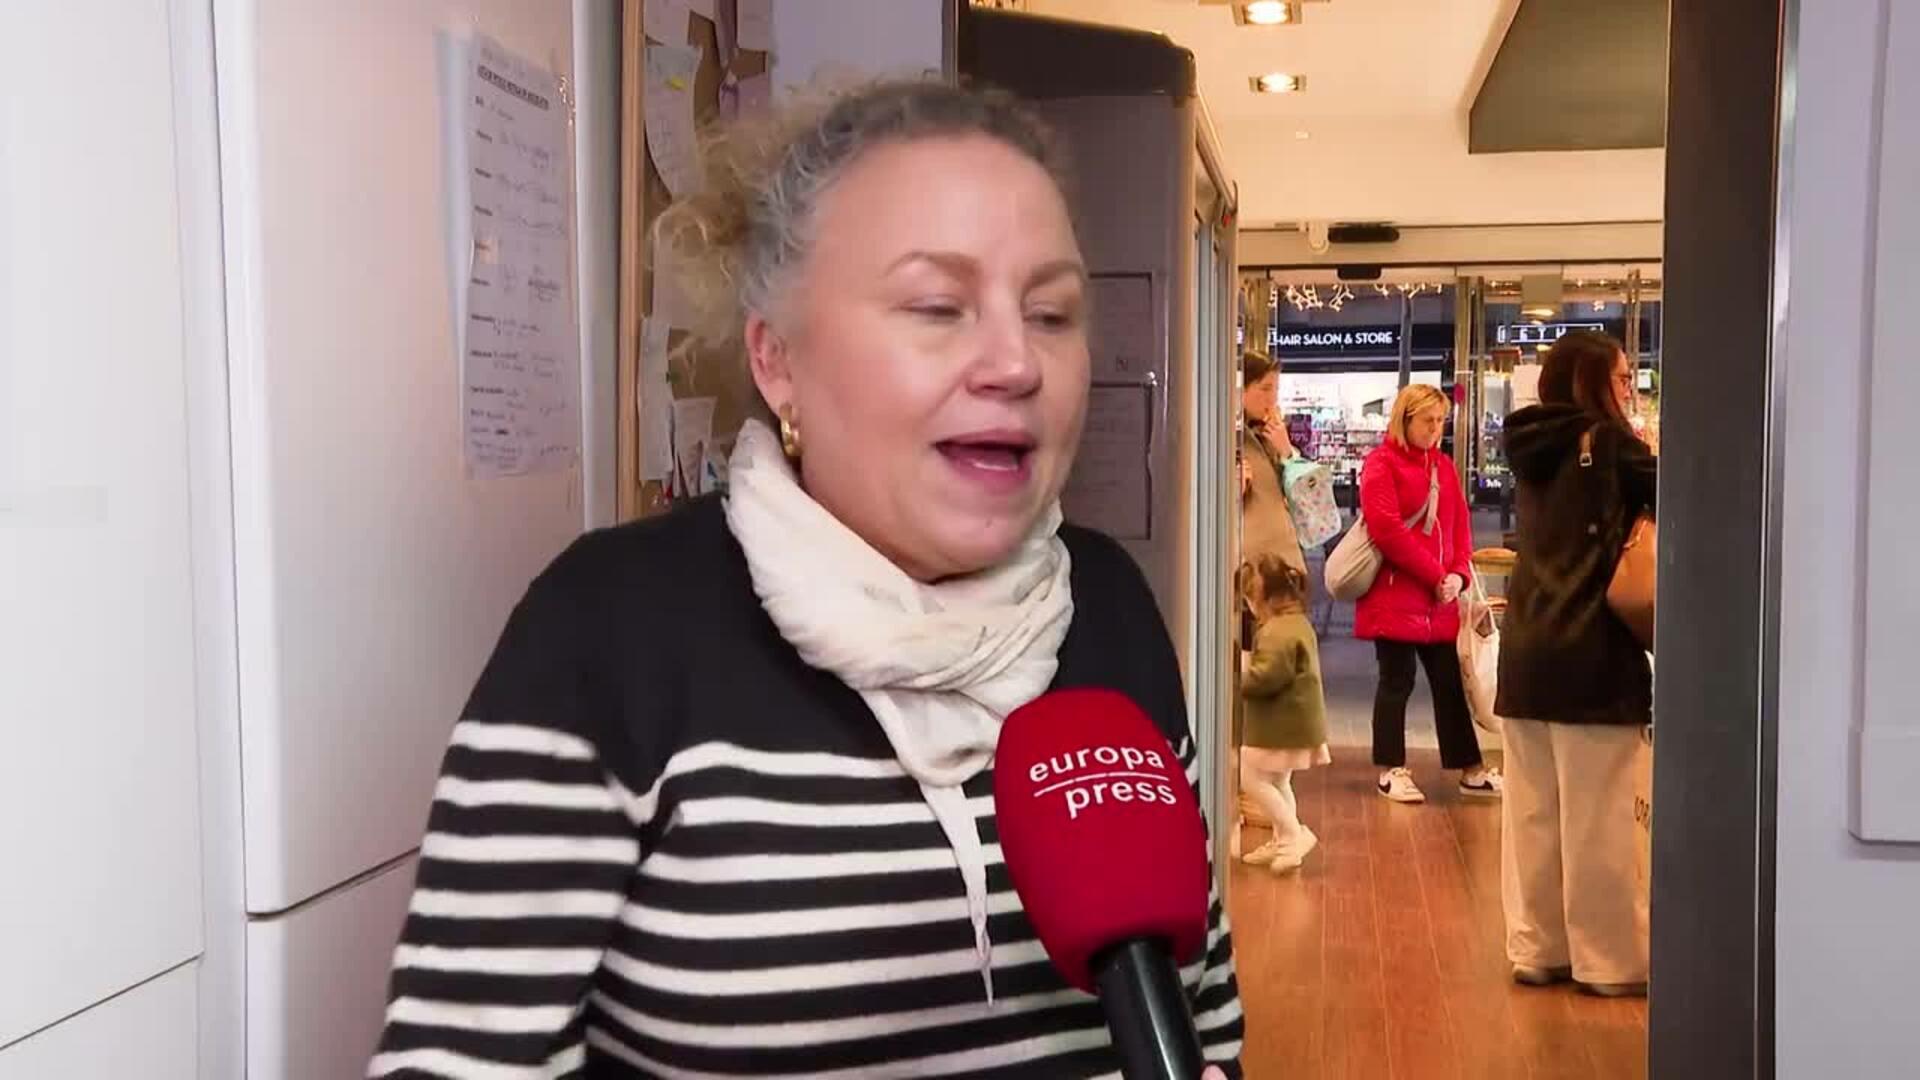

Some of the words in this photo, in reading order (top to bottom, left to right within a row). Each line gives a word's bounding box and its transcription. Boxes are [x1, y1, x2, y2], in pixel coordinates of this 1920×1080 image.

[1275, 333, 1303, 346] HAIR
[1304, 333, 1342, 346] SALON
[1344, 333, 1354, 345] &
[1355, 332, 1394, 345] STORE
[1029, 746, 1165, 782] europa
[1065, 781, 1177, 819] press
